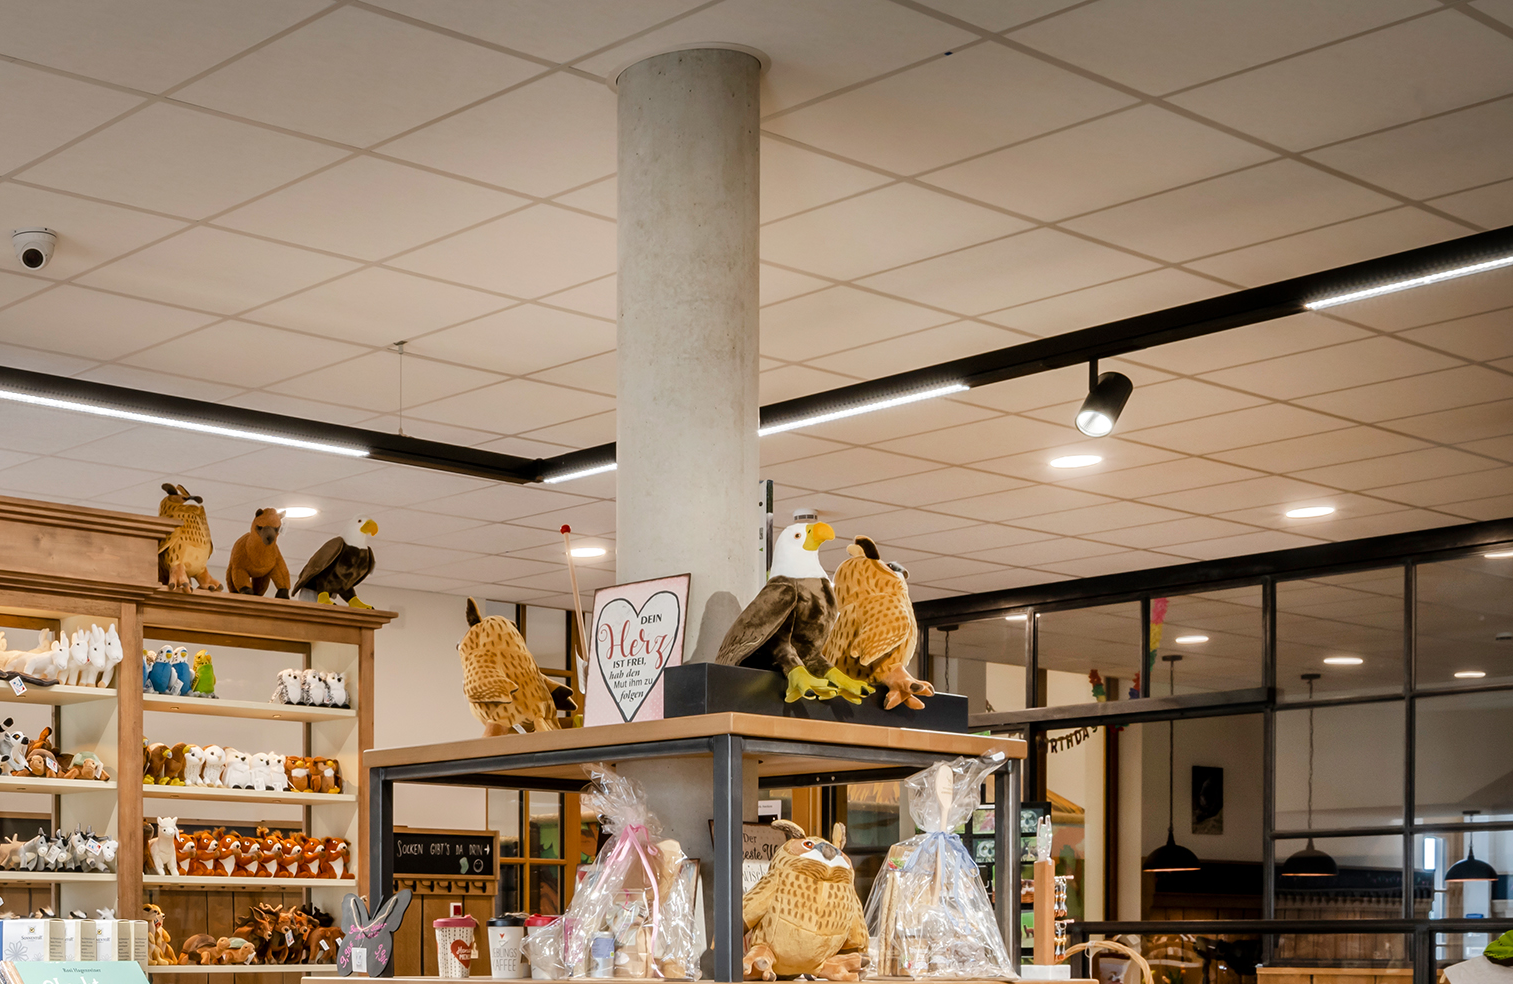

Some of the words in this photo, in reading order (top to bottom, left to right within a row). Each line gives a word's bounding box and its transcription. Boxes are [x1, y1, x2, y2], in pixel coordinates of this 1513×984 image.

[641, 613, 662, 625] DEIN
[597, 619, 674, 670] Herz
[613, 659, 626, 669] IST
[626, 657, 646, 668] FREI,
[609, 670, 624, 680] hab
[626, 668, 640, 678] den
[614, 680, 628, 689] Mut
[629, 678, 642, 687] ihm
[644, 677, 653, 686] zu
[618, 689, 644, 704] folgen
[456, 844, 464, 856] DA
[469, 844, 483, 856] DRIN
